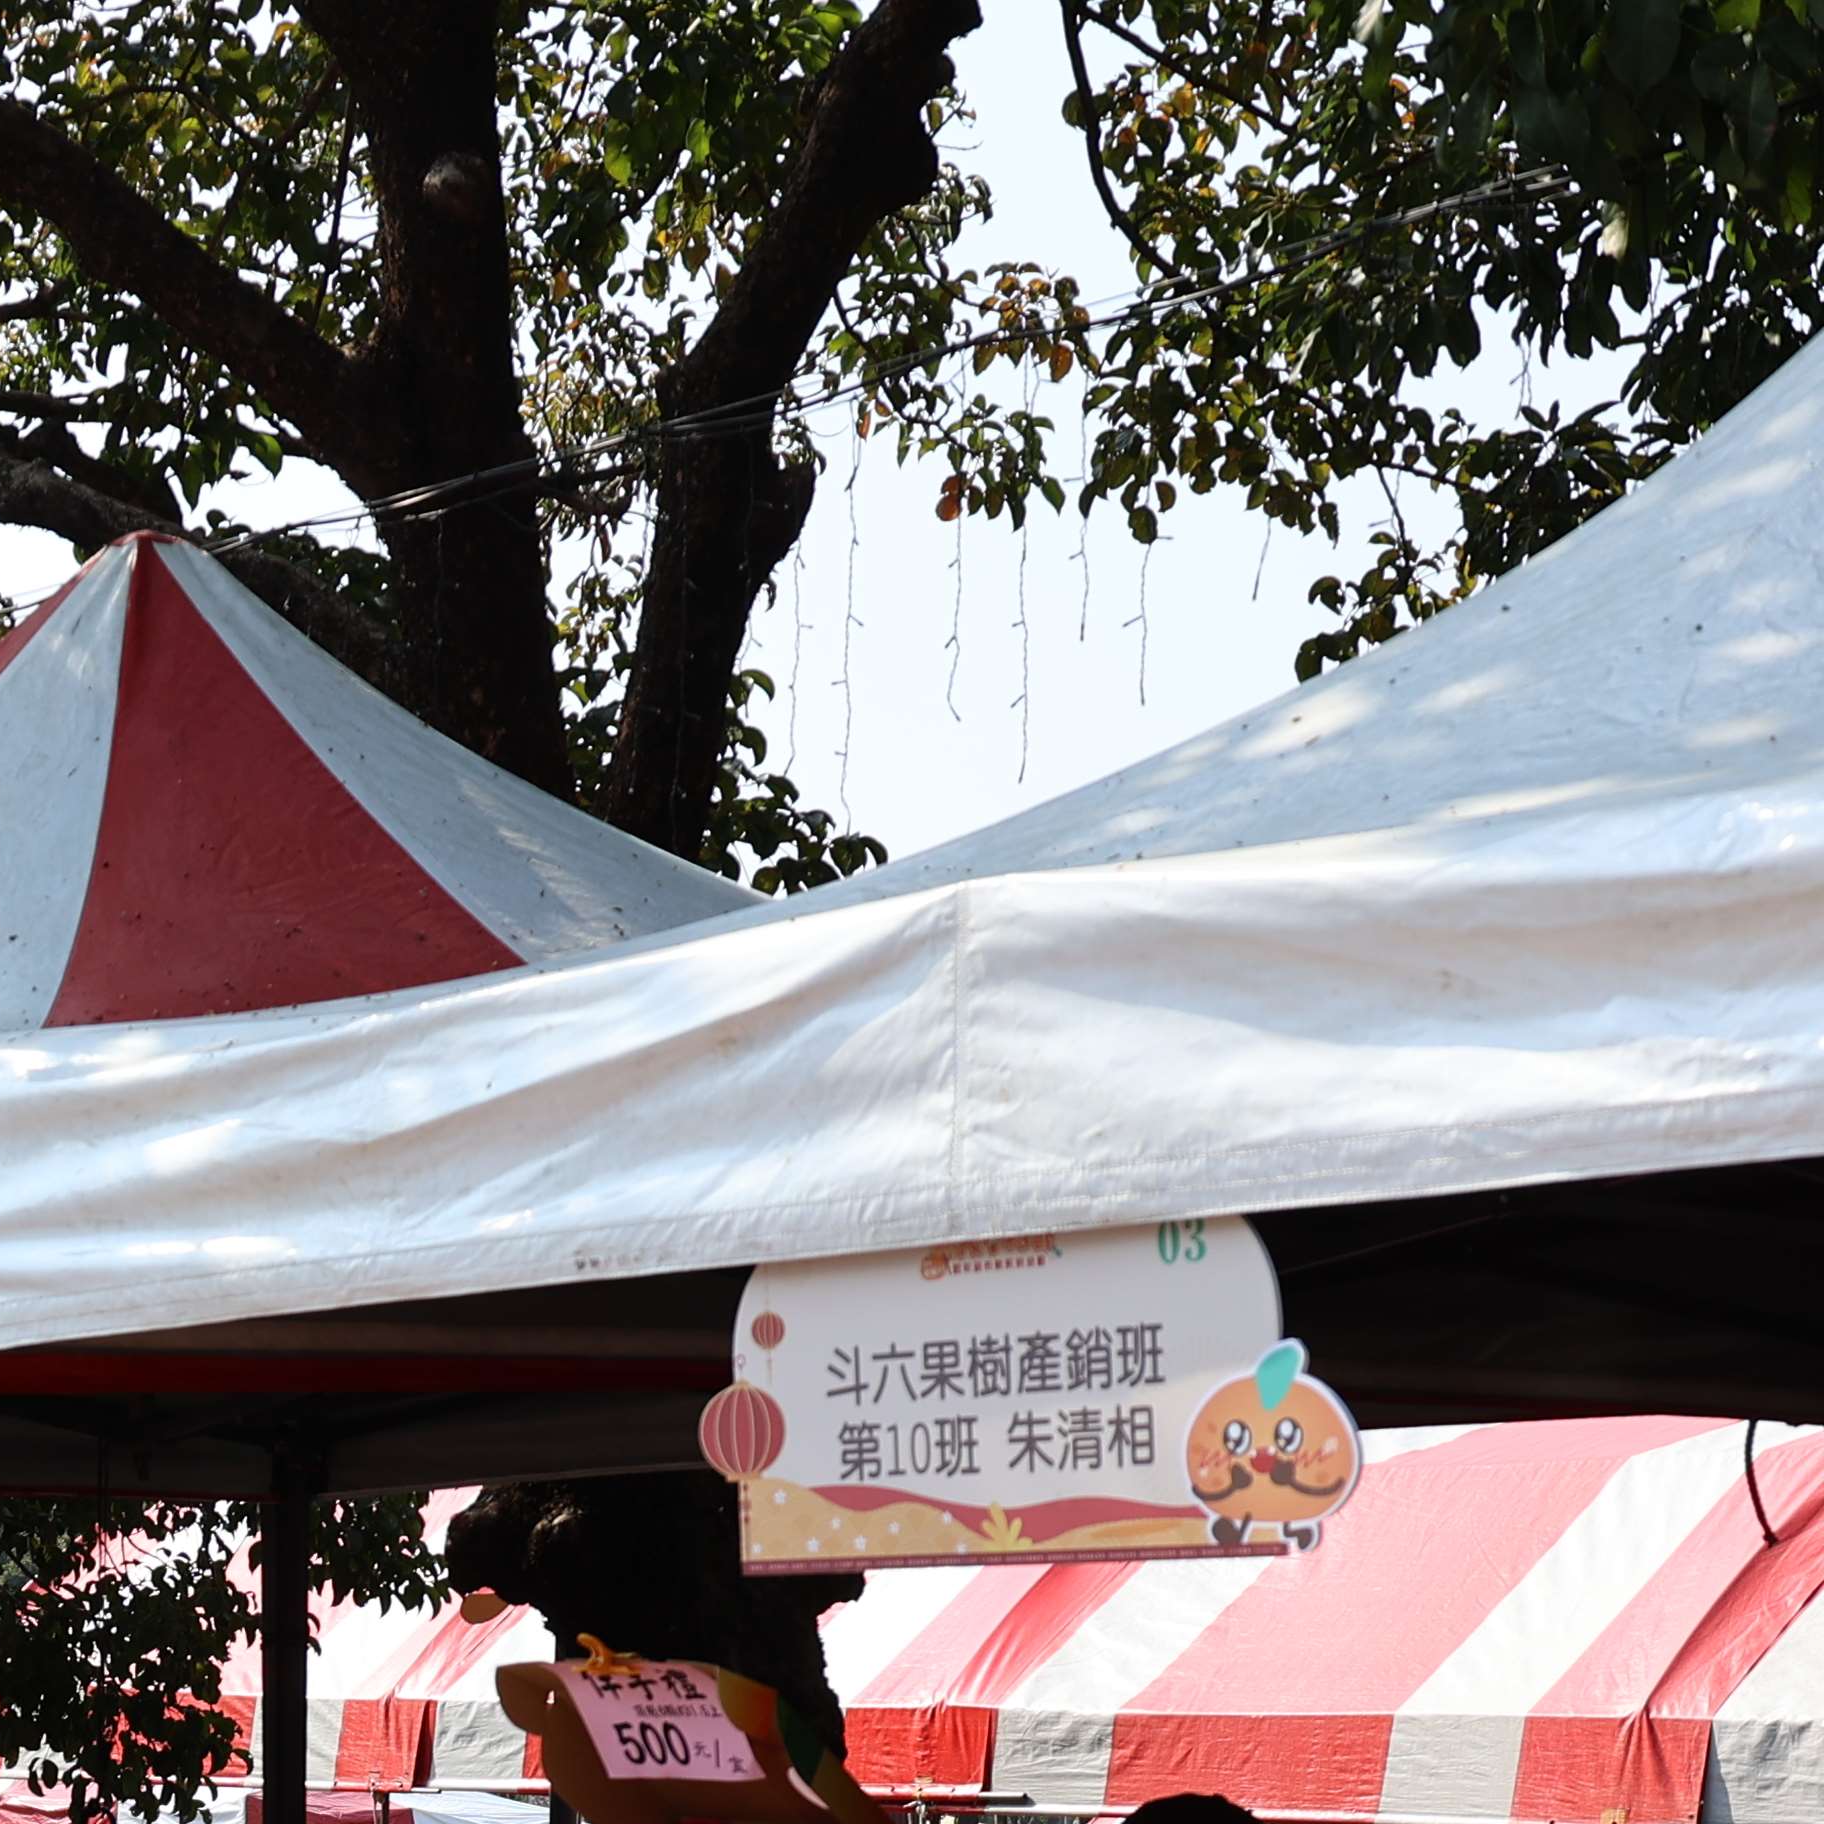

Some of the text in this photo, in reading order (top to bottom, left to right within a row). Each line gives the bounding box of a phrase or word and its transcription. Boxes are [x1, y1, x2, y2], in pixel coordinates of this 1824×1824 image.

[1157, 1219, 1207, 1265] 03
[826, 1323, 1166, 1406] 斗六果樹產銷班
[839, 1405, 1155, 1482] 第10班 朱清相
